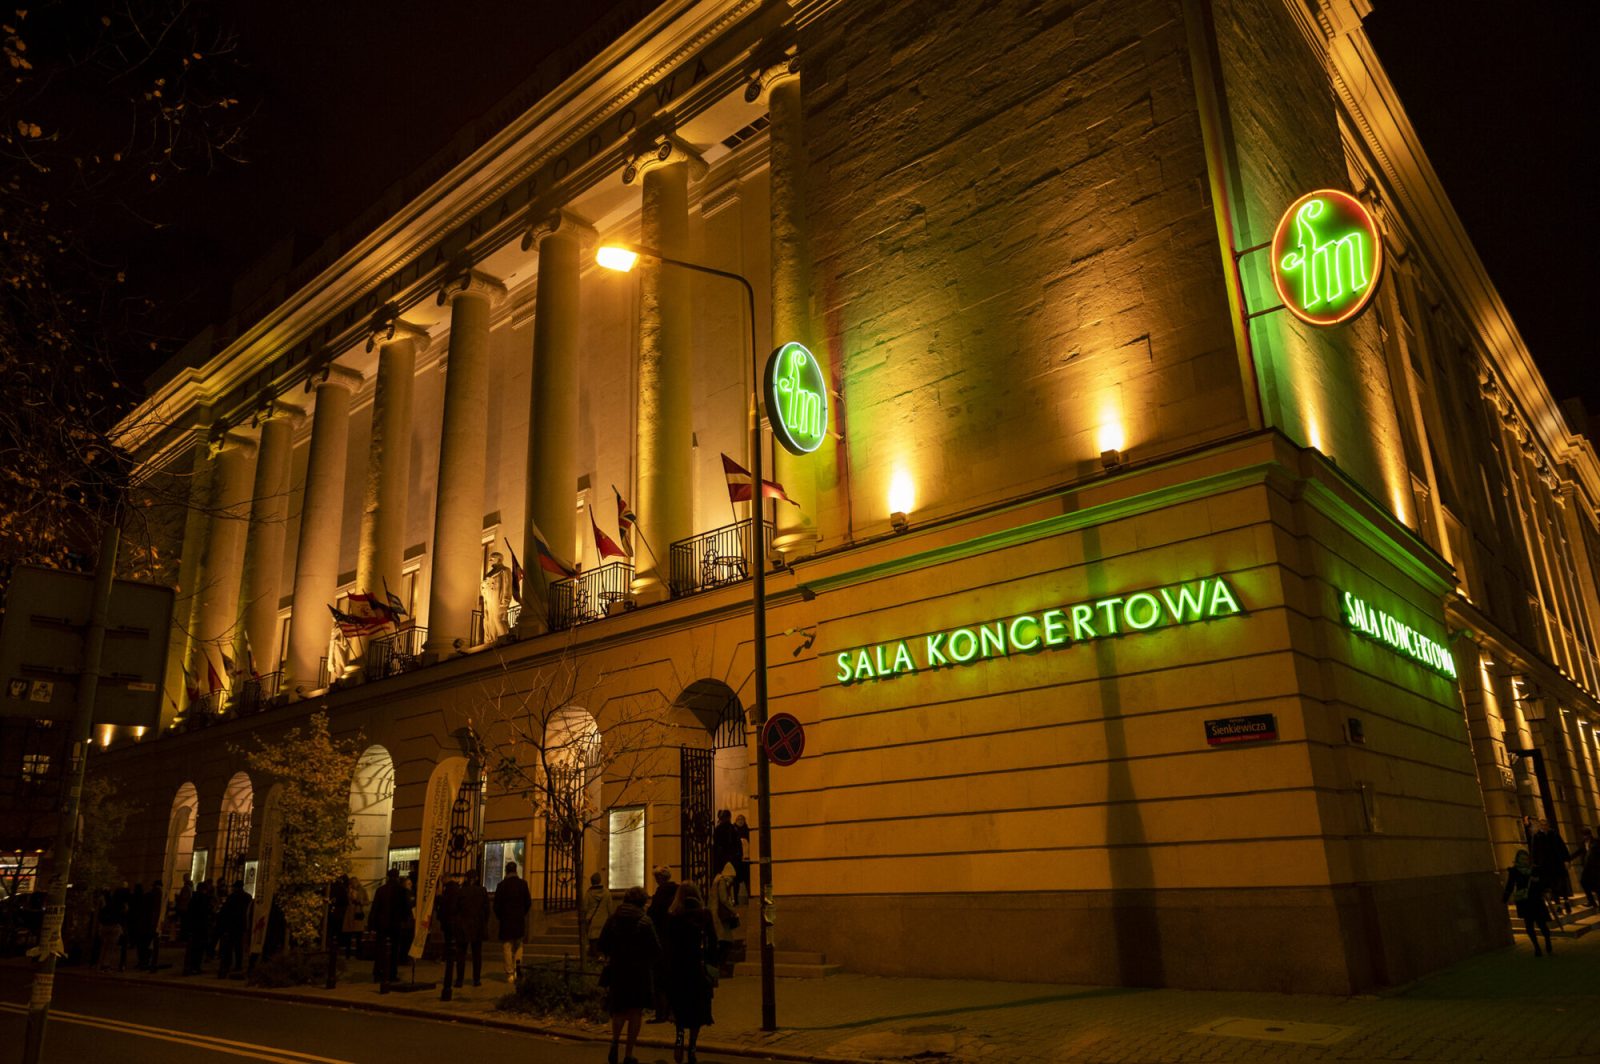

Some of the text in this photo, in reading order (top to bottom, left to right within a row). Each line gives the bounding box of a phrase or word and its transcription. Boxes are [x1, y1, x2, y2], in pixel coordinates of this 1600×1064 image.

[469, 57, 709, 243] NARODOWA
[836, 576, 1242, 684] SALA KONCERTOWA
[1344, 591, 1457, 679] SALA KONCERTOWA
[1211, 722, 1267, 736] Sienkiewicza
